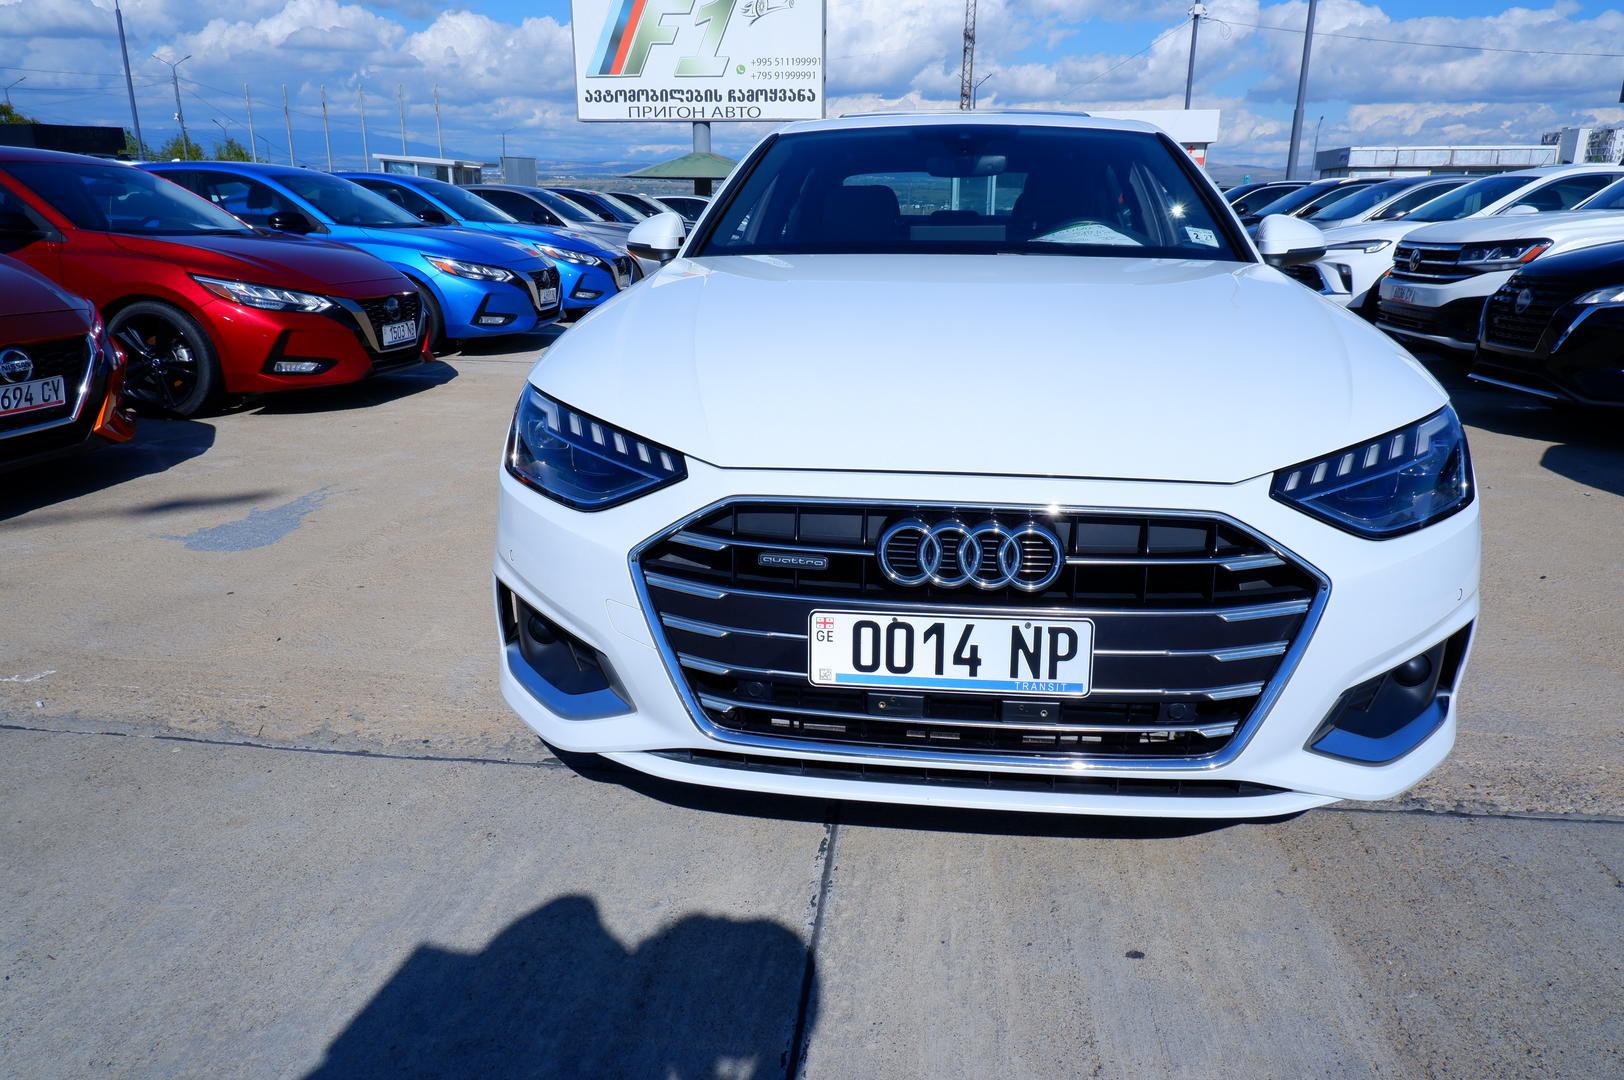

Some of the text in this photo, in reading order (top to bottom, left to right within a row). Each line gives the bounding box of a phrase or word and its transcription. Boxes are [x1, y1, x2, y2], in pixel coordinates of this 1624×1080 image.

[621, 0, 737, 77] F1
[751, 57, 821, 66] +995 511199991
[751, 71, 816, 80] +795 91999991
[584, 88, 816, 103] ავტომობილების ჩამოყვანა
[628, 106, 762, 119] ПРИГОН АВТО
[0, 379, 60, 410] 694 CY
[762, 556, 824, 567] quattro
[816, 630, 834, 642] GE
[852, 620, 1078, 680] 0014 NP
[1015, 681, 1067, 692] TRANSIT
